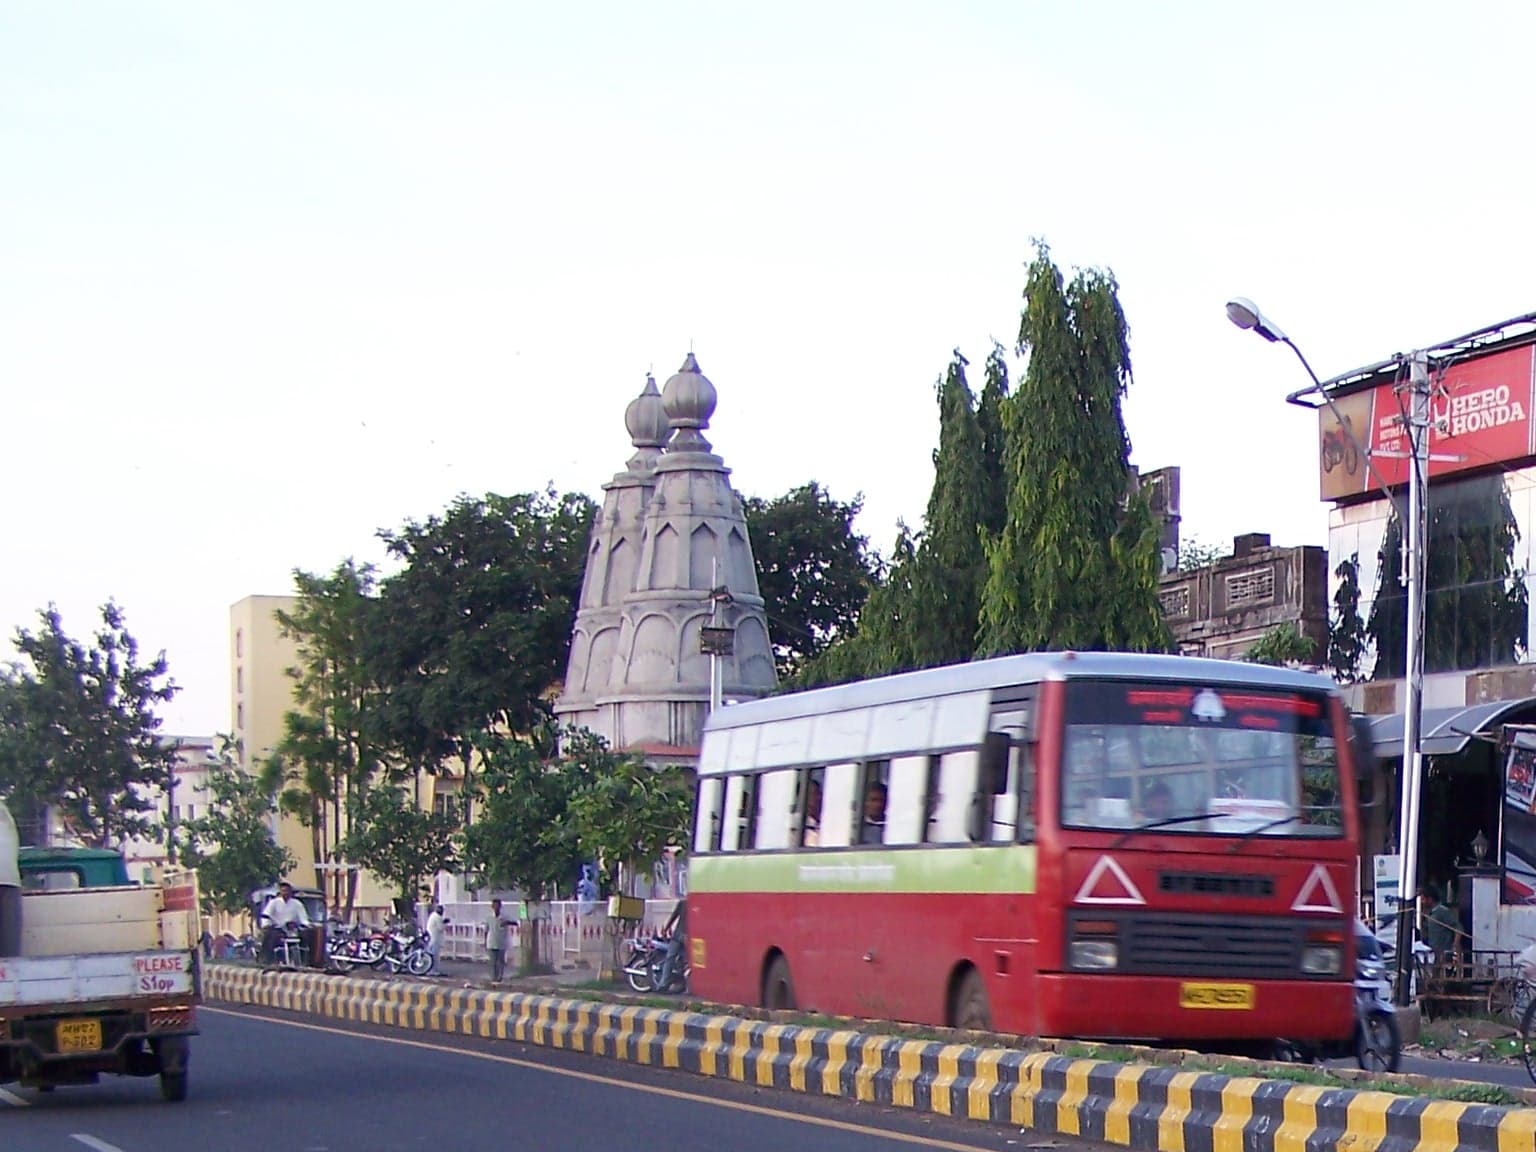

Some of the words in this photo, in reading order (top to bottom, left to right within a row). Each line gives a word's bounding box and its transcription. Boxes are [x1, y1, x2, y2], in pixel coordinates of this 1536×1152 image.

[1452, 384, 1510, 417] HERO
[1452, 401, 1526, 436] HONDA
[136, 957, 182, 972] PLEASE
